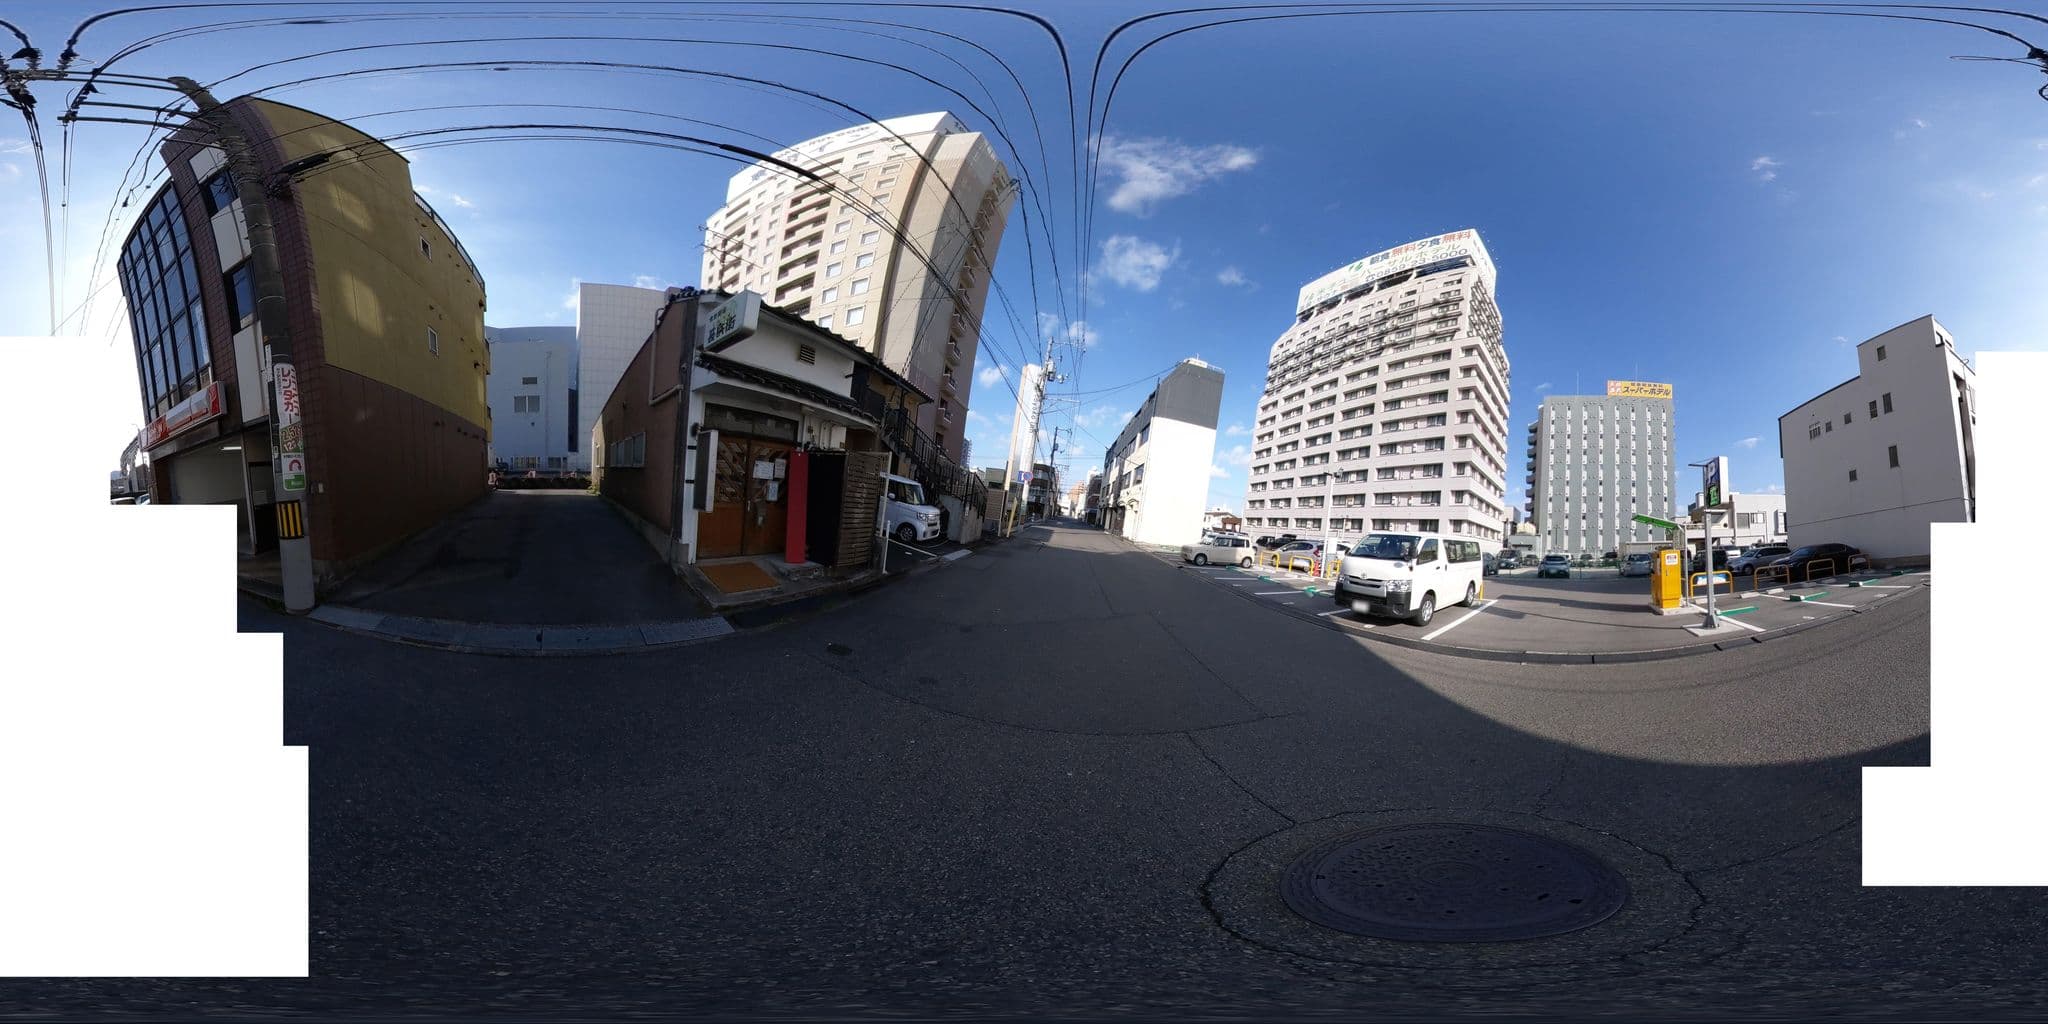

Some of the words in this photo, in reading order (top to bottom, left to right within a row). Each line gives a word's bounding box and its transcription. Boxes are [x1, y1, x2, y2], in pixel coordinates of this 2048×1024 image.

[281, 367, 294, 424] レンタカー
[1622, 386, 1671, 396] スーパーホテル
[1707, 461, 1716, 485] P
